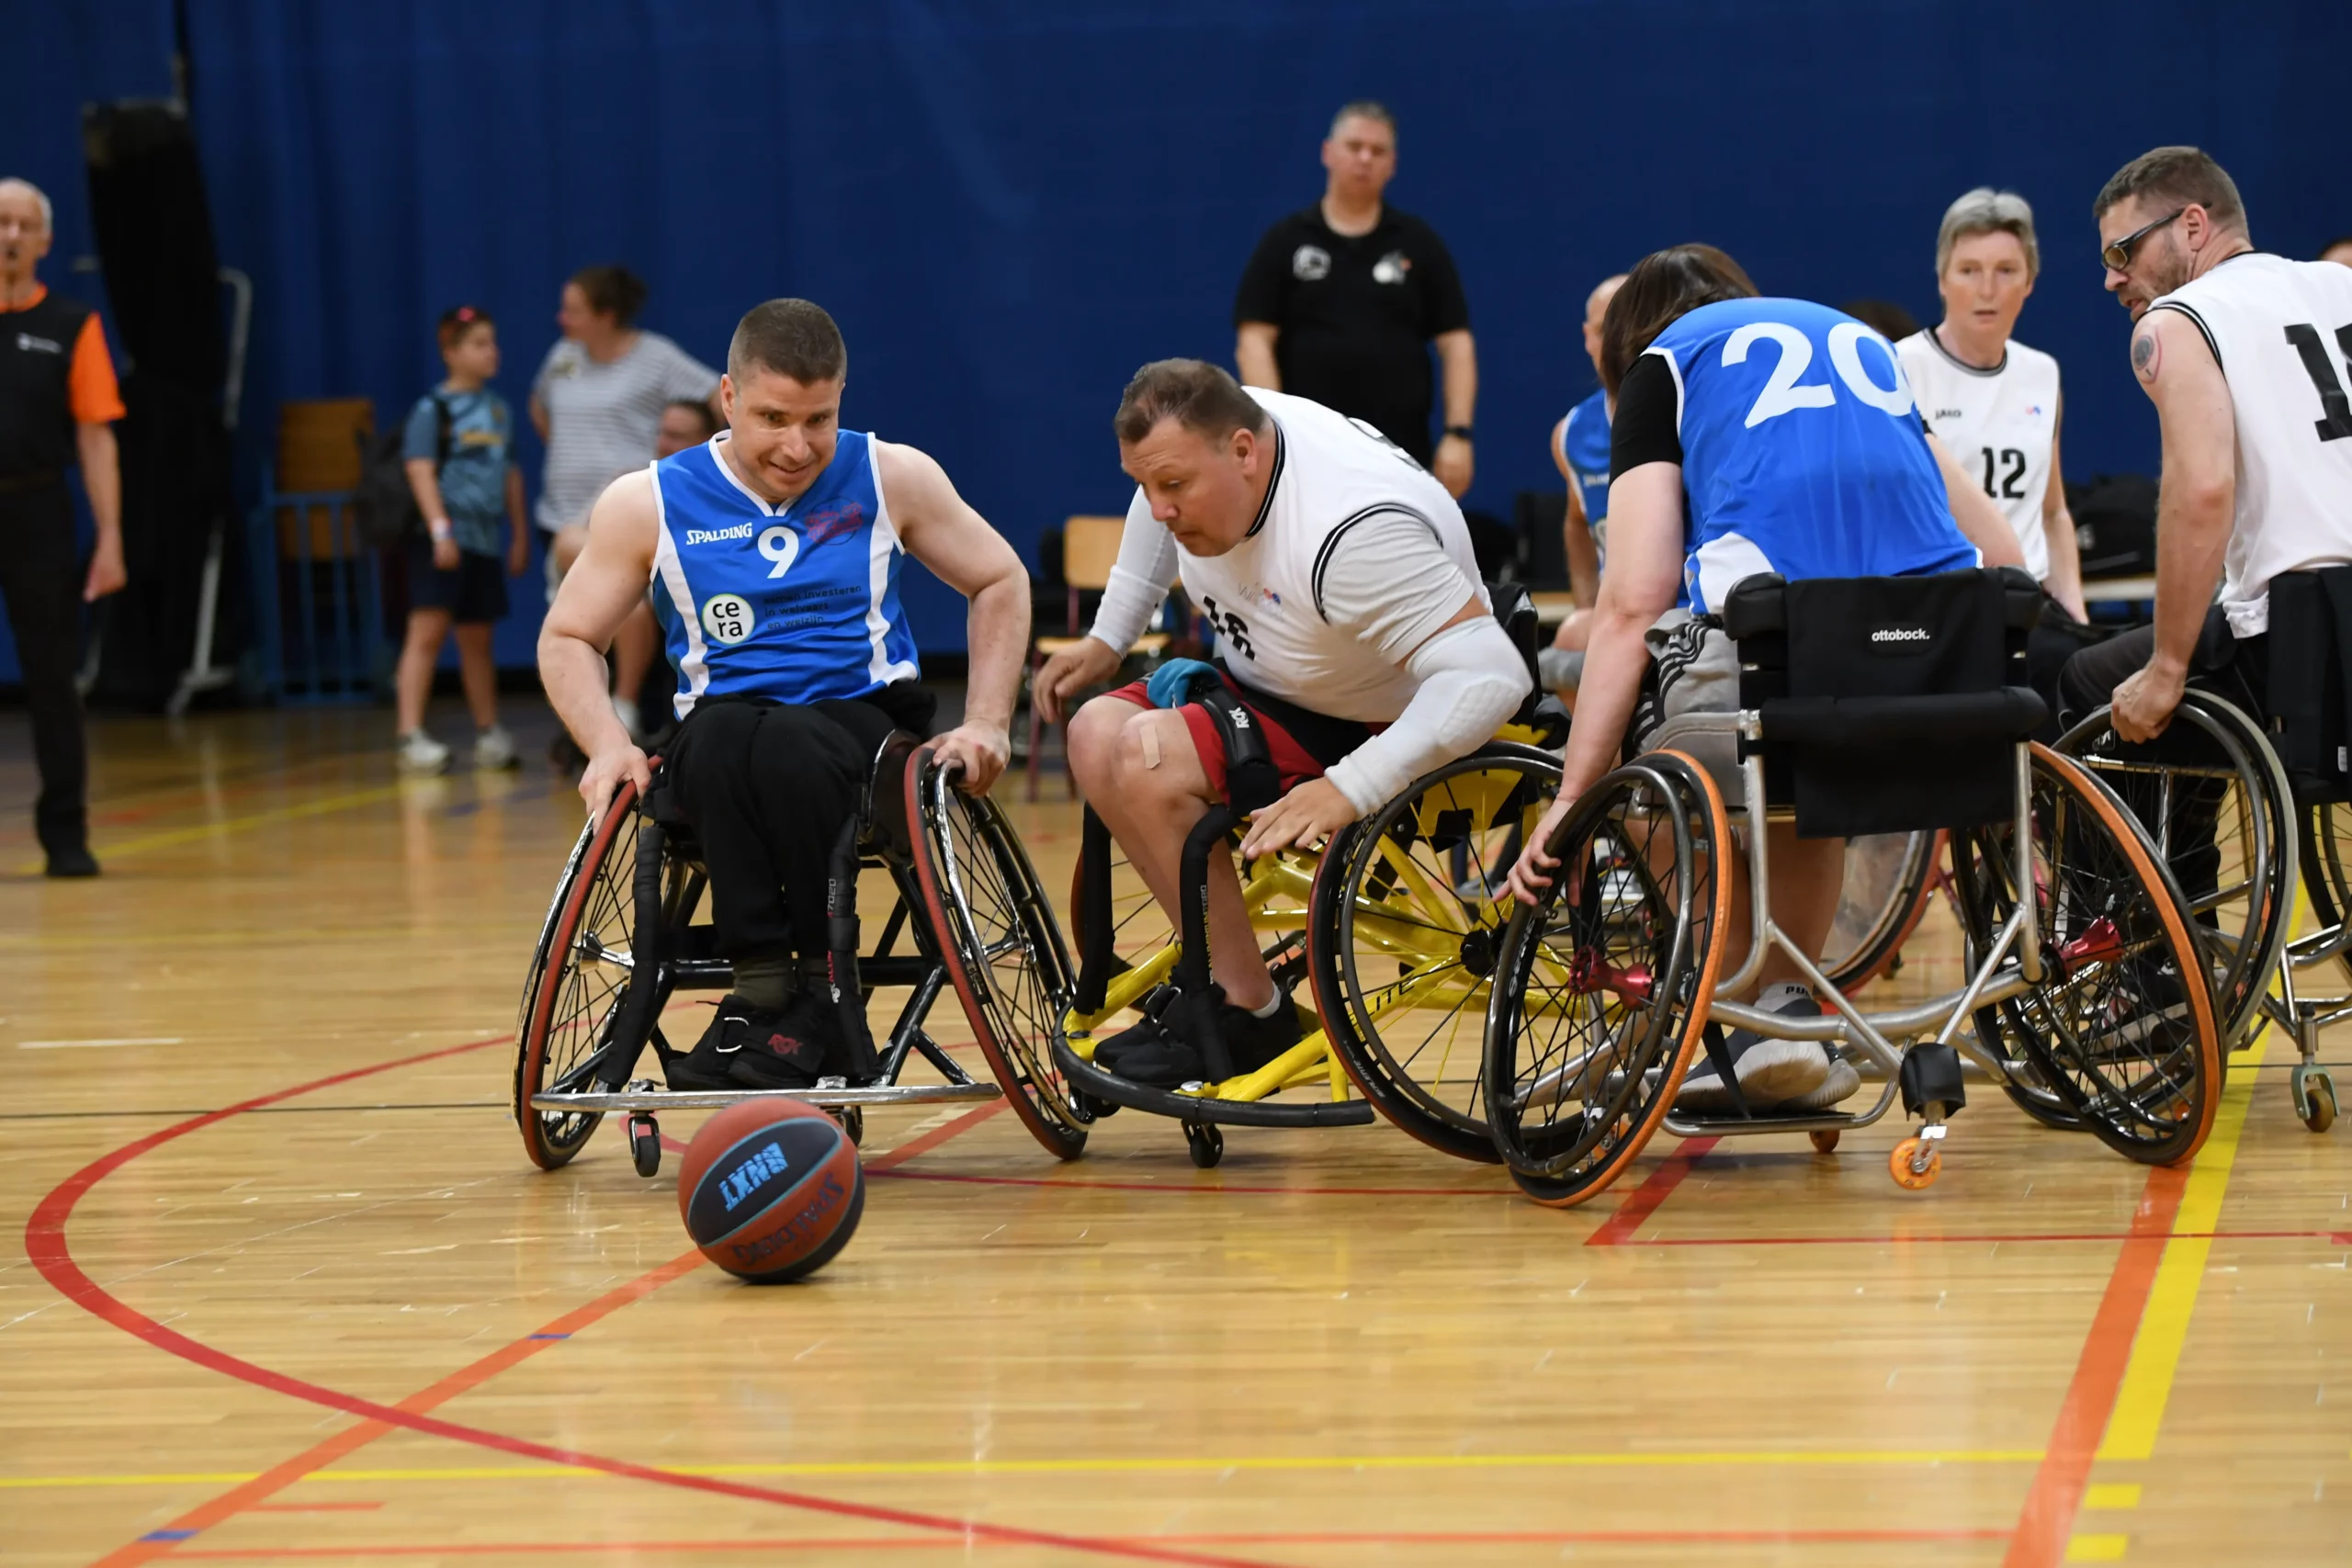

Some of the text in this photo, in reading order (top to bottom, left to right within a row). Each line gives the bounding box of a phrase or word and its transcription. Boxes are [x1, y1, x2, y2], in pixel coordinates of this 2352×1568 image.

[1721, 322, 1914, 429] 20
[2284, 322, 2352, 442] 1
[1982, 446, 2026, 498] 12
[686, 522, 752, 546] SPALDING
[757, 526, 799, 579] 9
[804, 585, 862, 598] investeren
[1871, 627, 1930, 642] ottobock.
[1786, 987, 1808, 997] PU
[731, 1173, 844, 1267] SPALDING
